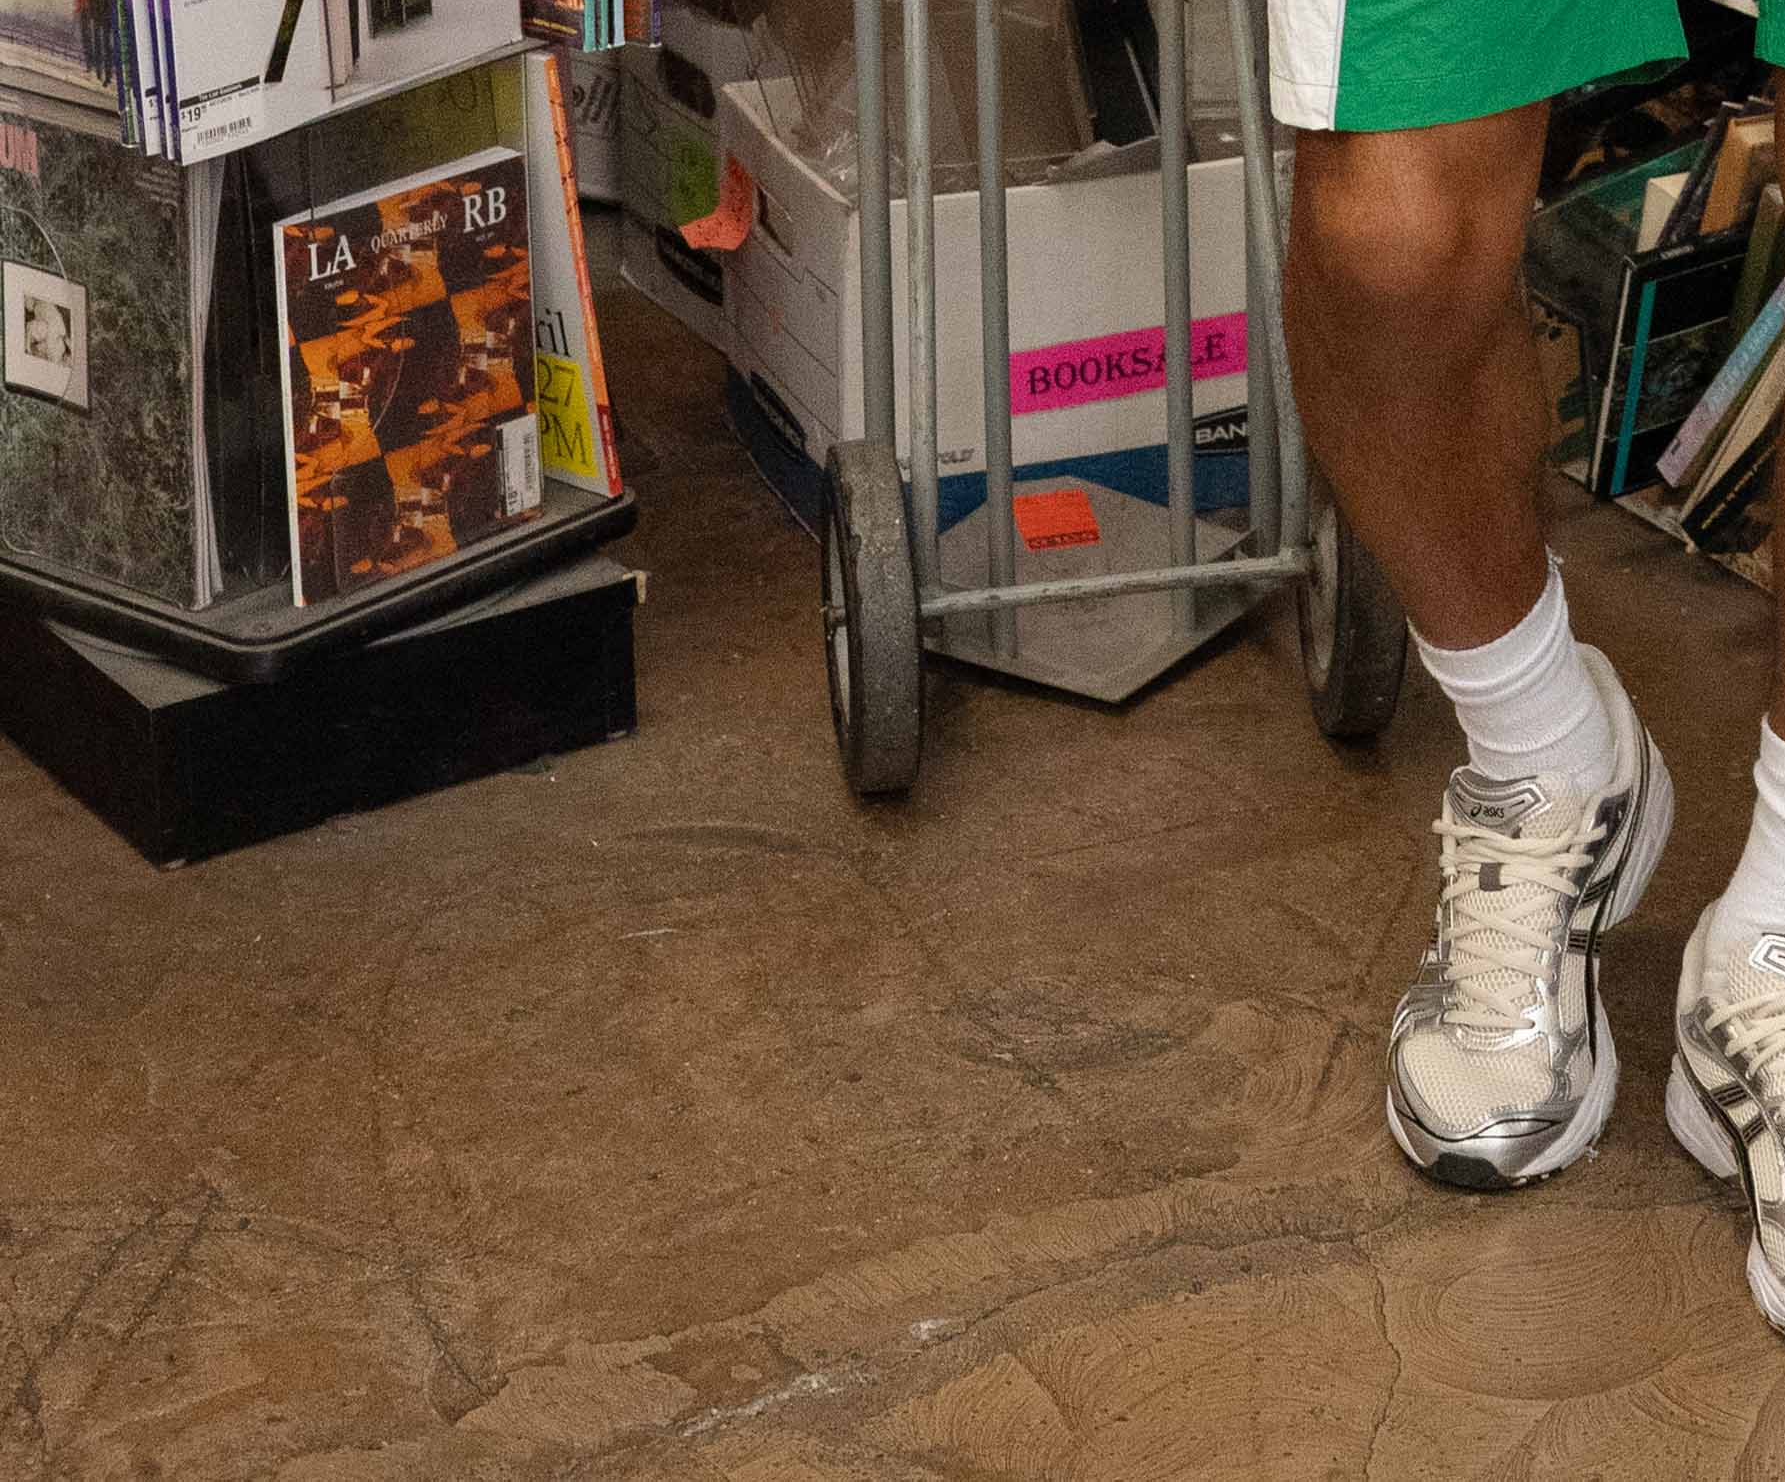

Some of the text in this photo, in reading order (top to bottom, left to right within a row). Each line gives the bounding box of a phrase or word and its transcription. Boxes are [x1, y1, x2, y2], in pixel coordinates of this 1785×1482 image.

[307, 234, 356, 281] LA
[462, 187, 506, 233] RB
[1027, 332, 1227, 396] BOOKSE
